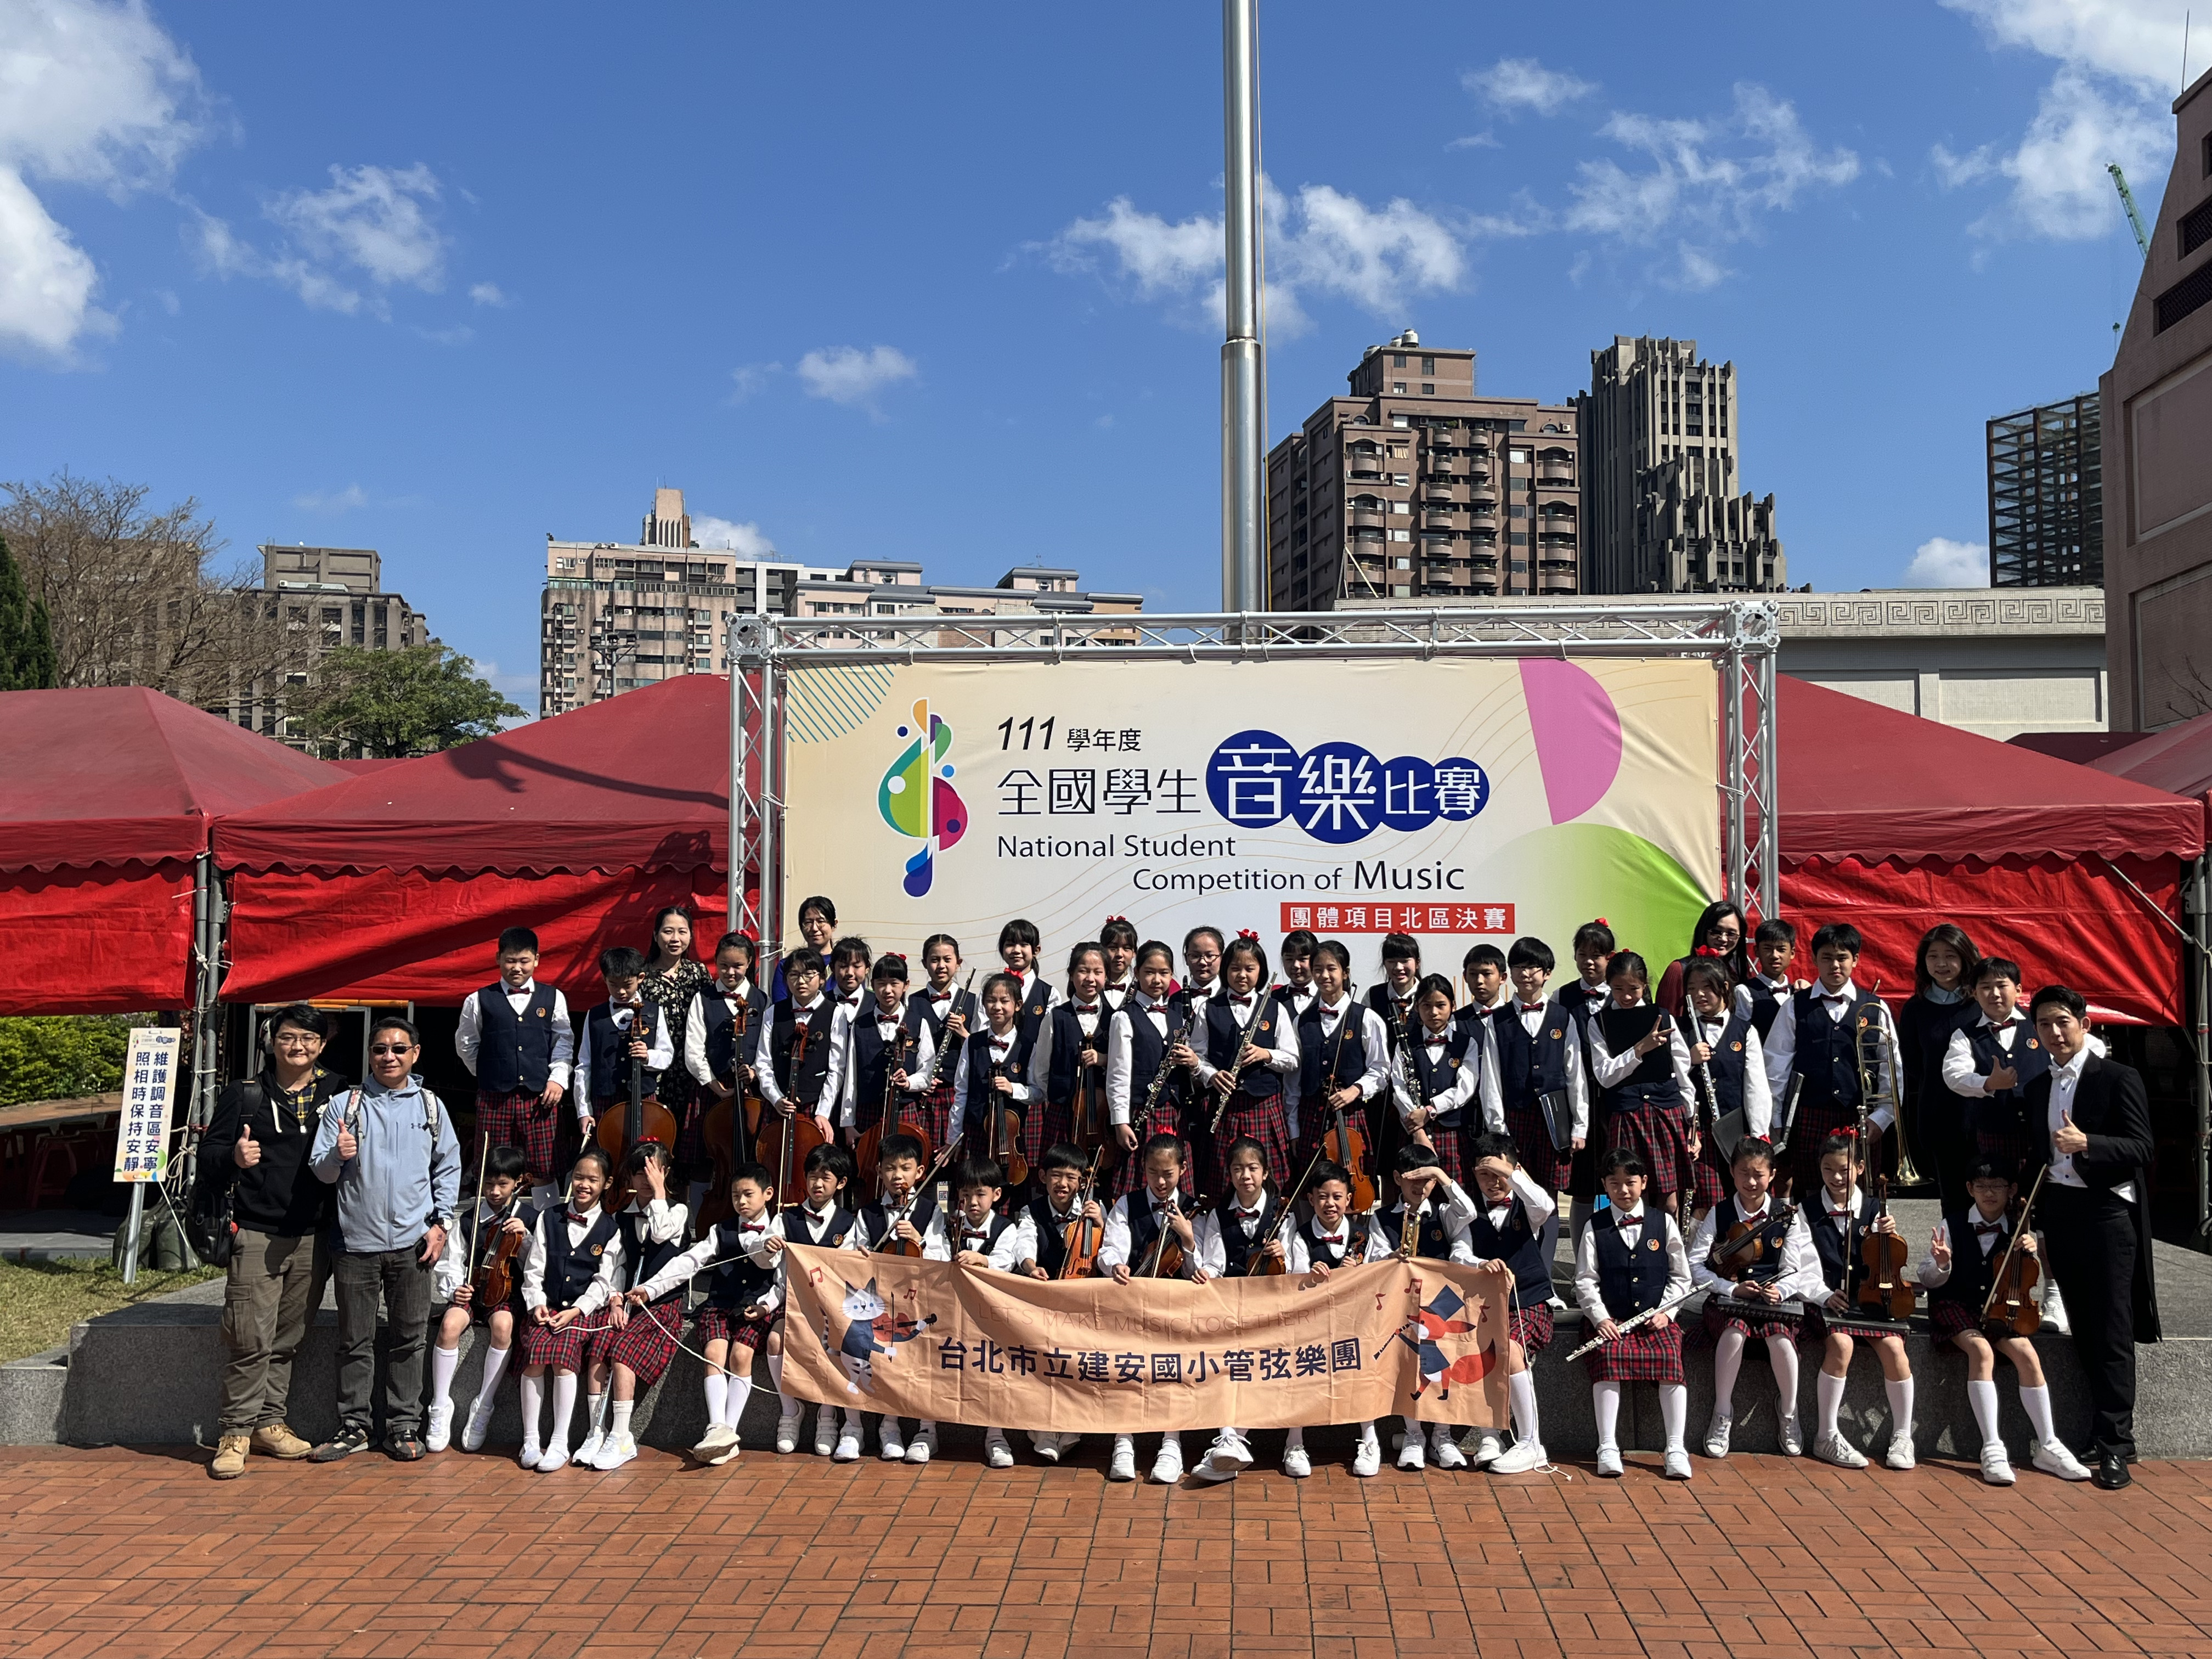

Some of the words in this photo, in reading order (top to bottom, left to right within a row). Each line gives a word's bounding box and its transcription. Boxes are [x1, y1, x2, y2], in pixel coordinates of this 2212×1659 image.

[998, 716, 1055, 751] 111
[1067, 727, 1141, 752] 學年度
[998, 834, 1114, 857] National
[1124, 833, 1236, 857] Student
[1133, 868, 1305, 895] Competition
[1314, 867, 1343, 890] of
[1355, 860, 1464, 890] Music
[1290, 907, 1505, 929] 團體項目北區決賽
[123, 1052, 150, 1172] 照相時保持安靜
[144, 1052, 168, 1171] 維護調音區安寧
[978, 1303, 1033, 1325] LET'S
[1043, 1312, 1105, 1331] MAKE
[1114, 1316, 1184, 1333] MUSIC
[938, 1336, 1361, 1384] 台北市立建安國小管弦樂團
